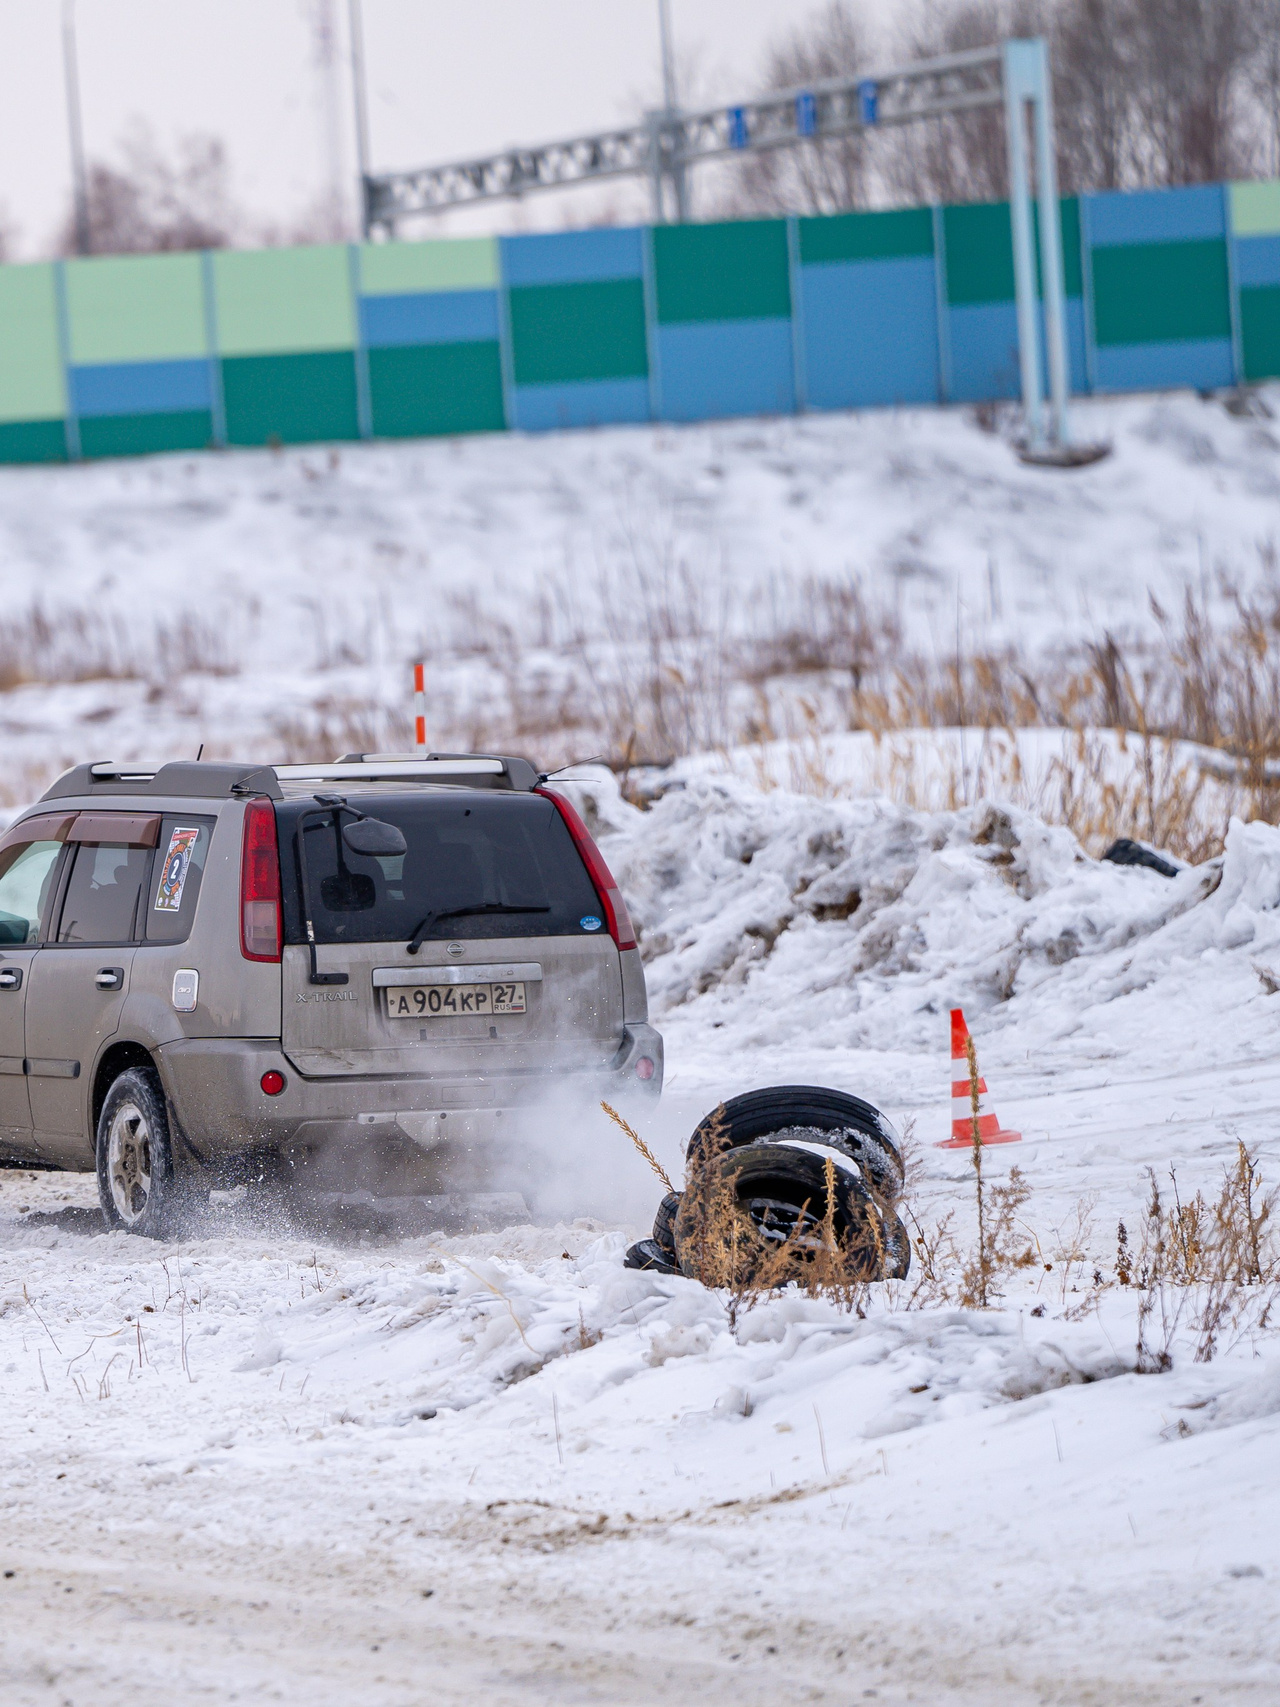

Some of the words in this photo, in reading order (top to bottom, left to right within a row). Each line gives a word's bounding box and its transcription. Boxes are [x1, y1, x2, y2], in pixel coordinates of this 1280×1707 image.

[170, 858, 180, 880] 2
[296, 990, 358, 1003] X-TRAIL
[494, 984, 517, 1004] 27
[494, 1003, 511, 1011] RUS
